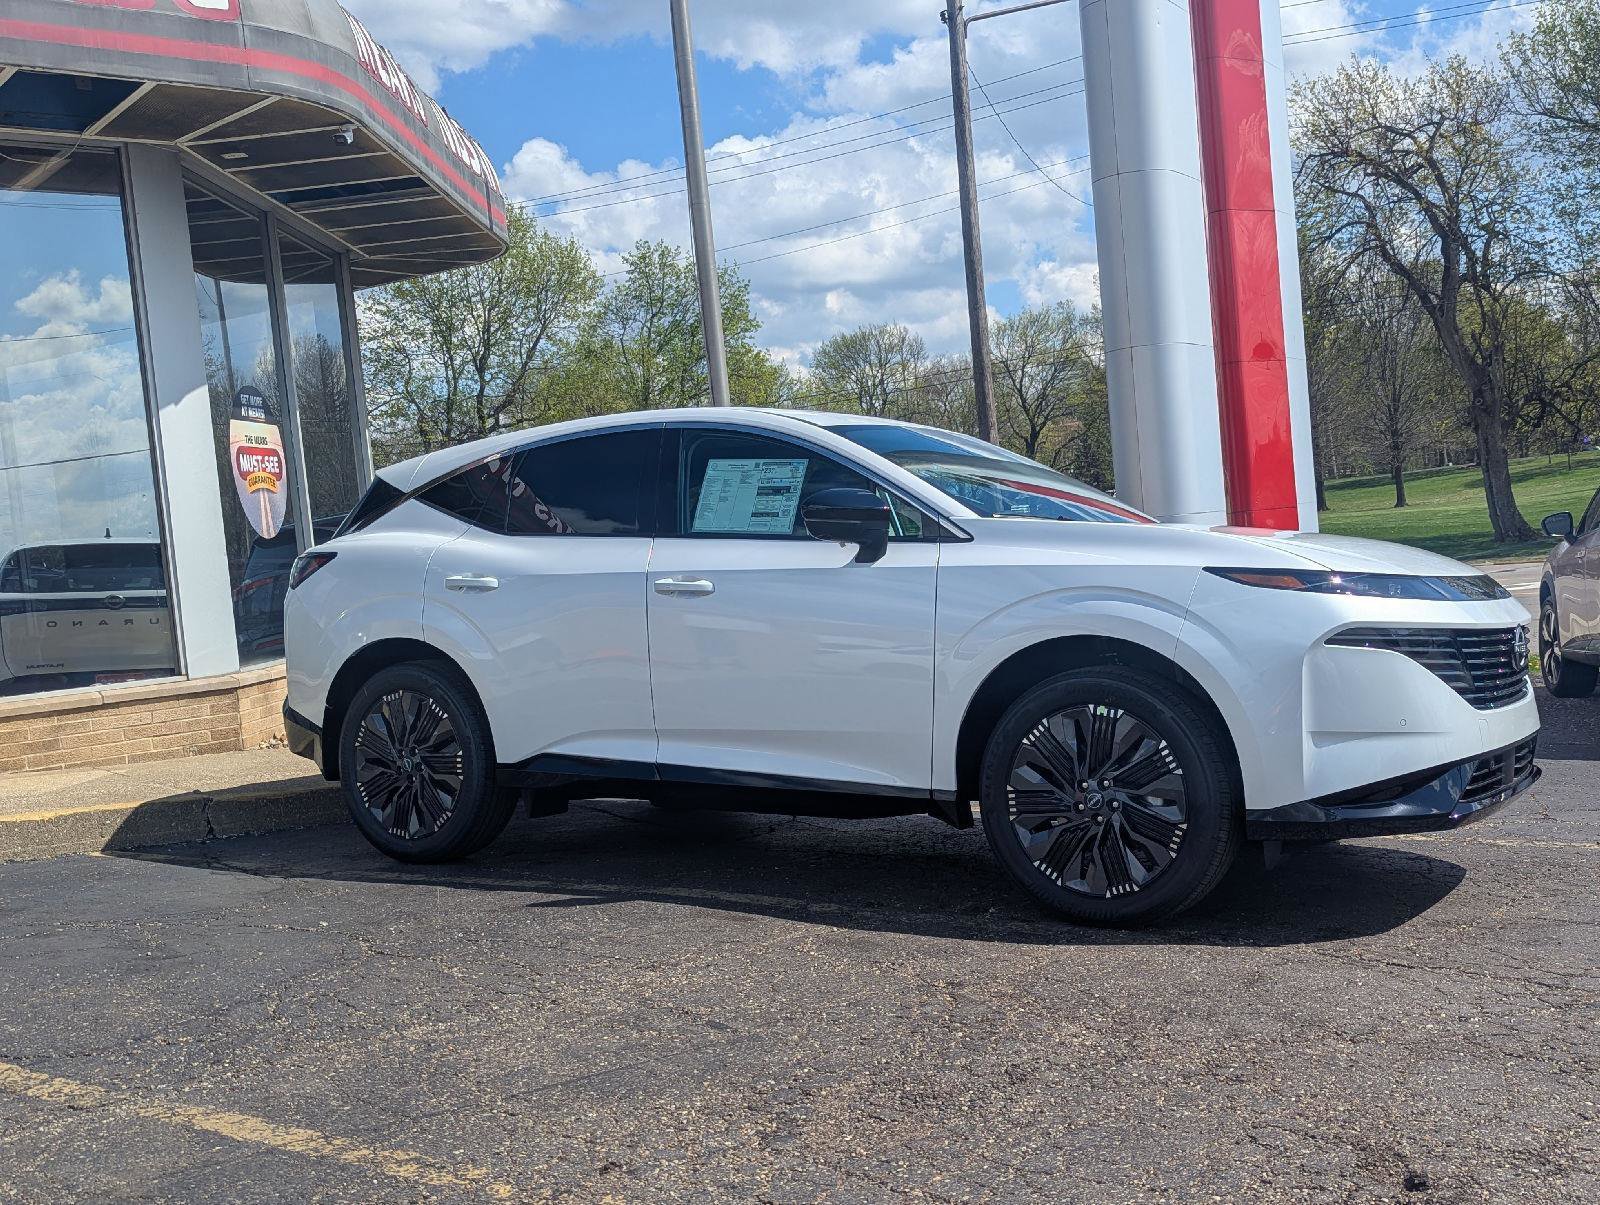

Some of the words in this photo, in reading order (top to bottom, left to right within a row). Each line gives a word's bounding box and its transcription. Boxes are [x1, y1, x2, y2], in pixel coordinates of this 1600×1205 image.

[244, 435, 254, 444] THE
[239, 454, 279, 473] MUST-SEE
[248, 476, 277, 488] GUARANTEE
